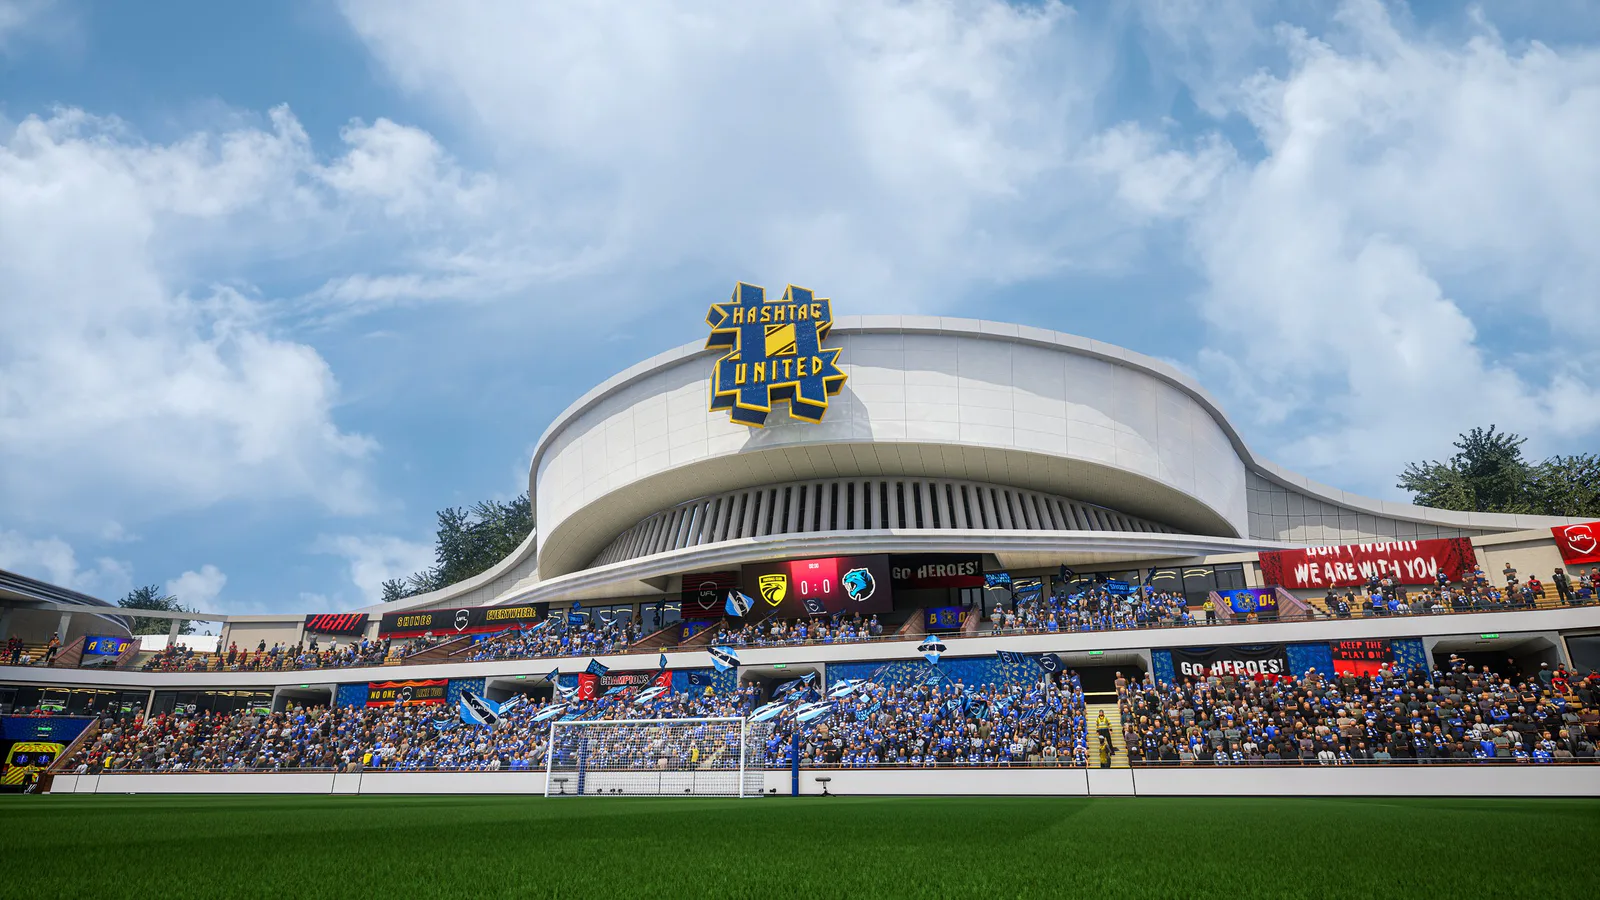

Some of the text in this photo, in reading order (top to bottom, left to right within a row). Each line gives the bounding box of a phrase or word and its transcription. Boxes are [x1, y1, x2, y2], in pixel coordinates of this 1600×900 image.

[733, 303, 822, 325] HASHTAG
[735, 355, 823, 385] UNITED
[1568, 534, 1593, 542] UFL
[892, 560, 979, 580] GO HEROES!
[1294, 556, 1438, 586] WE ARE WITH YOU
[801, 580, 809, 595] 0
[823, 579, 831, 594] 0
[1259, 594, 1276, 606] 04
[307, 613, 364, 631] FIGHT!
[397, 614, 432, 628] SHINES
[486, 606, 537, 621] EVERYWHERE
[1340, 640, 1383, 649] KEEP THE
[1341, 651, 1385, 659] PLAY ON!
[1180, 658, 1285, 677] GO HEROES!
[600, 674, 649, 686] CHAMPIONS
[370, 690, 381, 699] NO
[382, 690, 396, 699] ONE
[415, 688, 430, 698] LIKE
[431, 687, 443, 697] YOU
